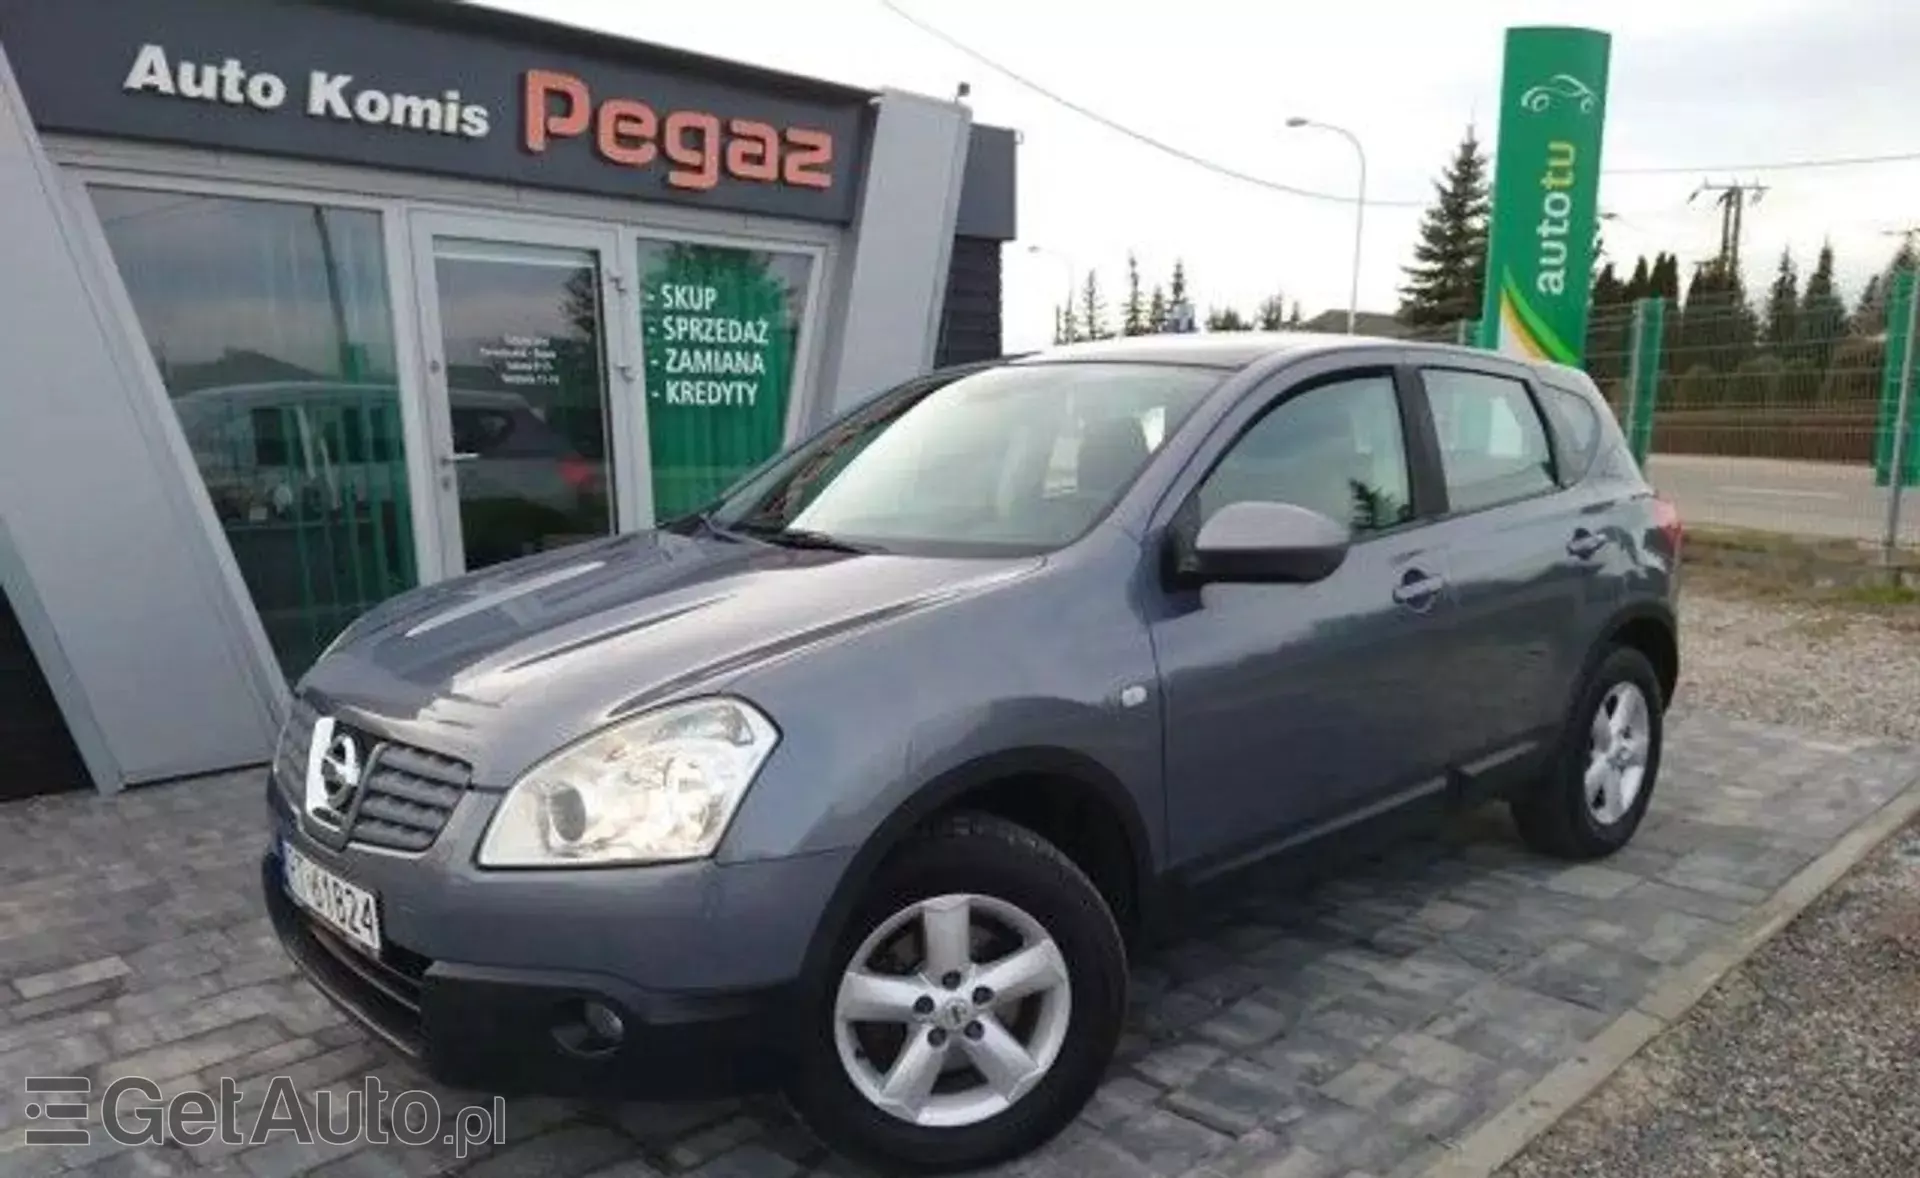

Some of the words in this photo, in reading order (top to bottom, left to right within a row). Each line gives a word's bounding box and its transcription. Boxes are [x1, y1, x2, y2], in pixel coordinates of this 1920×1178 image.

[124, 45, 286, 109] Auto
[308, 69, 490, 138] Komis
[524, 69, 834, 191] Pegaz
[1536, 141, 1575, 296] autotu
[660, 283, 717, 313] SKUP
[662, 316, 770, 345] SPRZEDAŻ
[665, 347, 765, 375] ZAMIANA
[666, 379, 758, 407] KREDYTY
